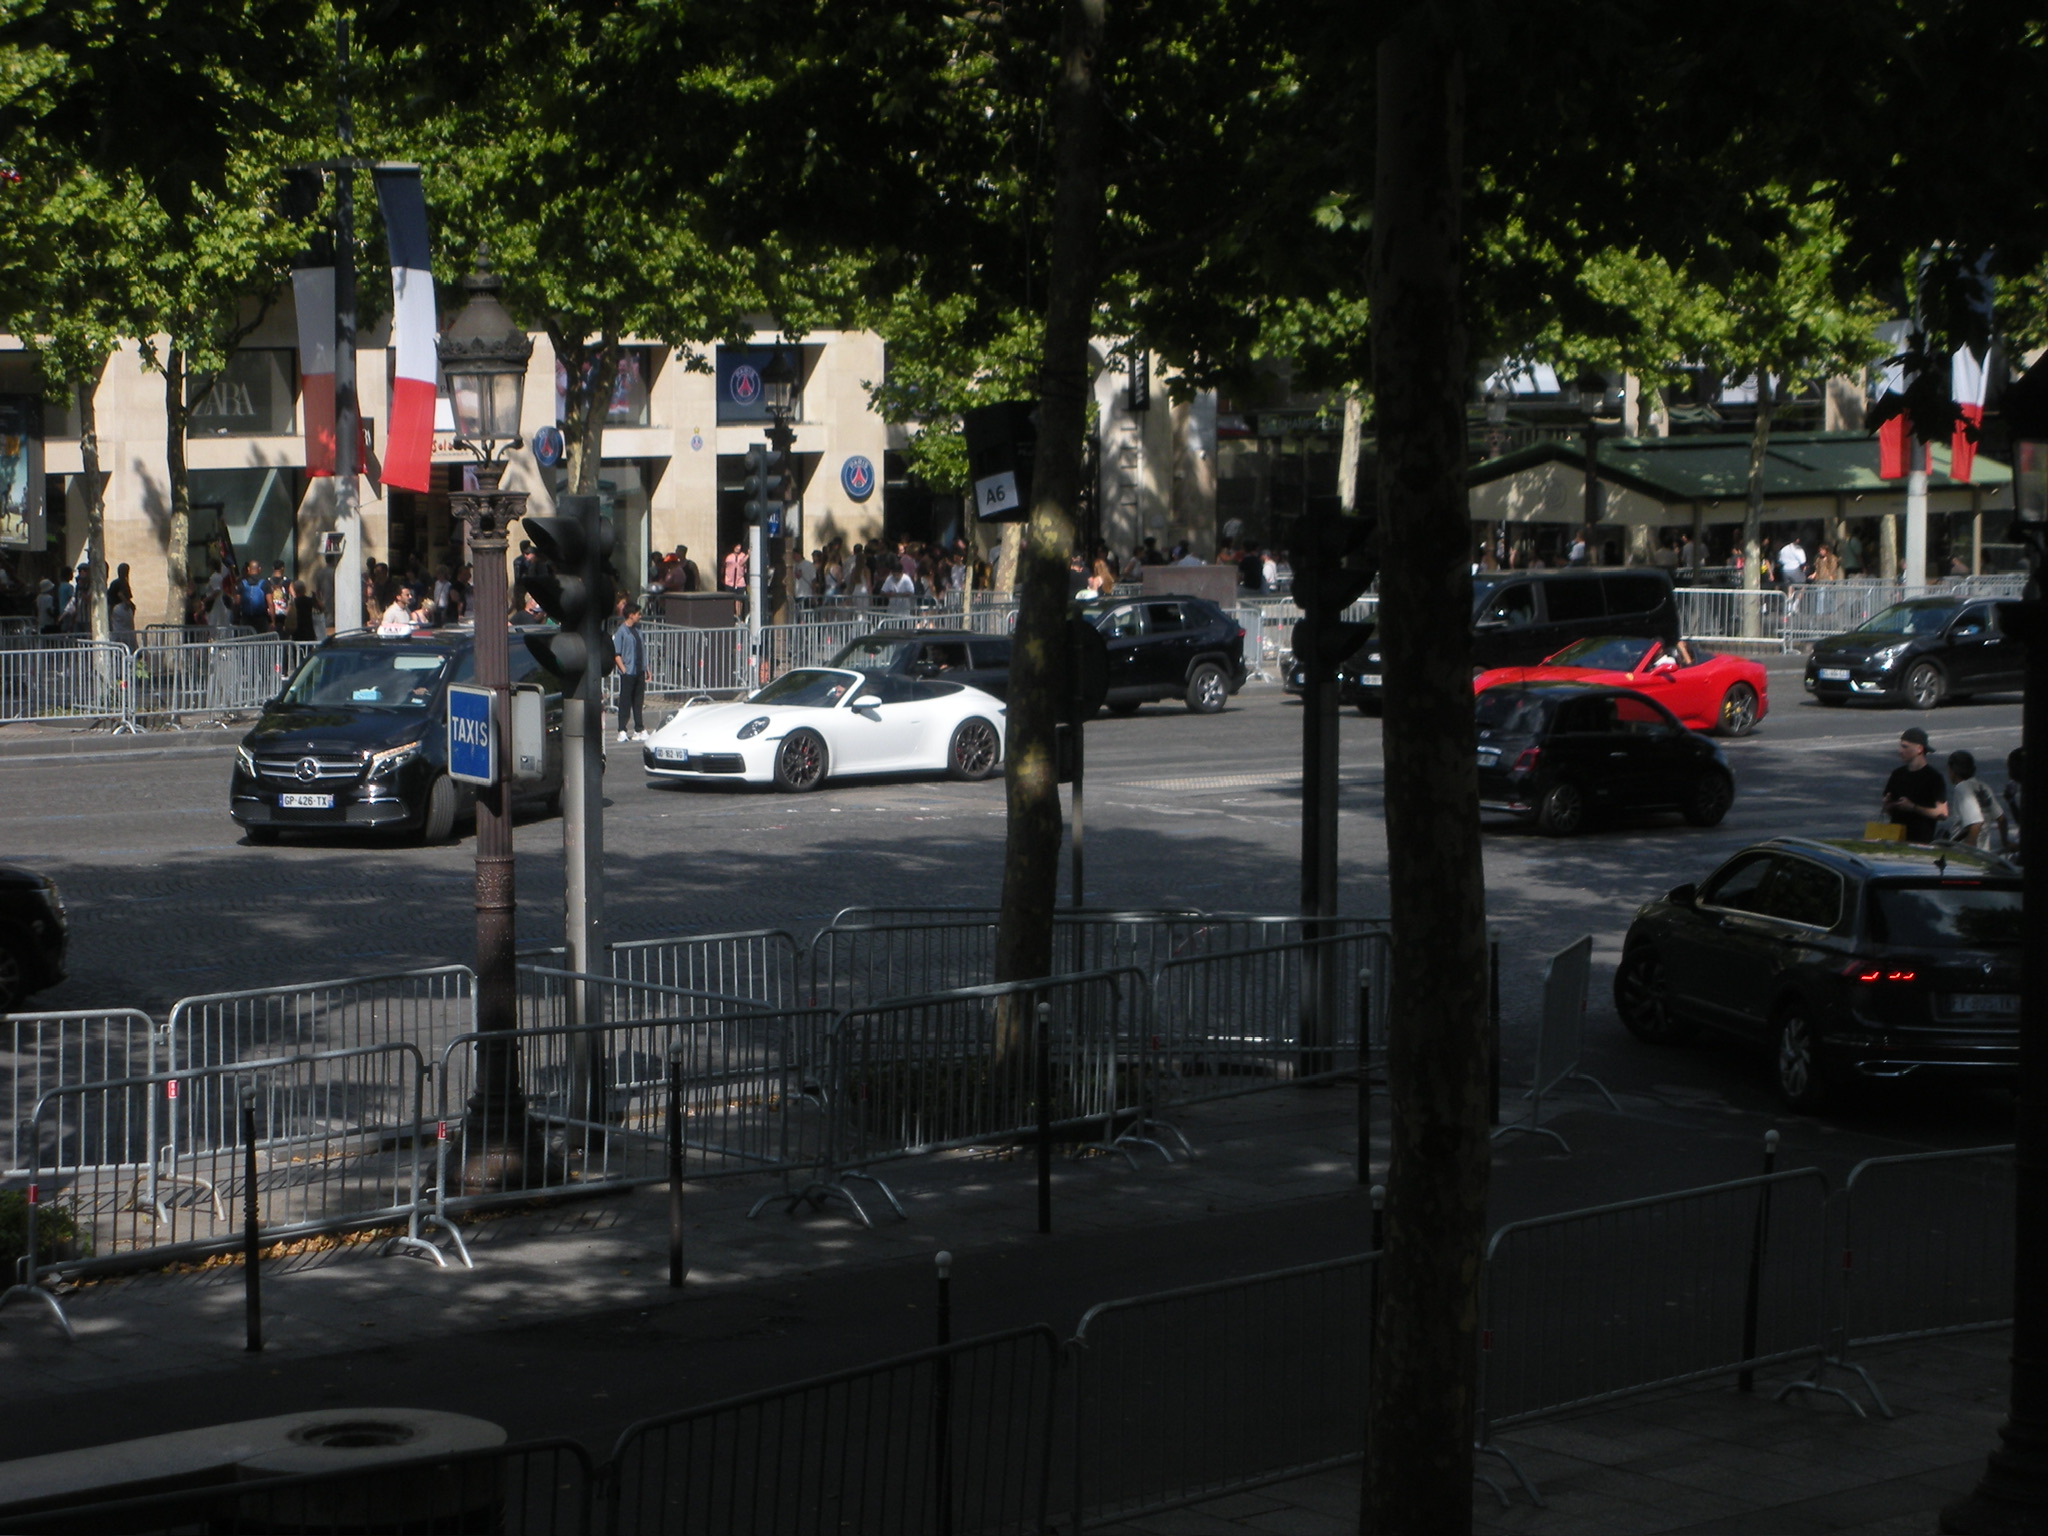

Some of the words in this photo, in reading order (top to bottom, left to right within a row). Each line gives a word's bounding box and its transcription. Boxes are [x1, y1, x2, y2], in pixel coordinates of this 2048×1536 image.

[191, 381, 256, 417] ZARA
[848, 457, 870, 469] PARIS
[986, 485, 1006, 506] A6
[452, 715, 488, 747] TAXIS
